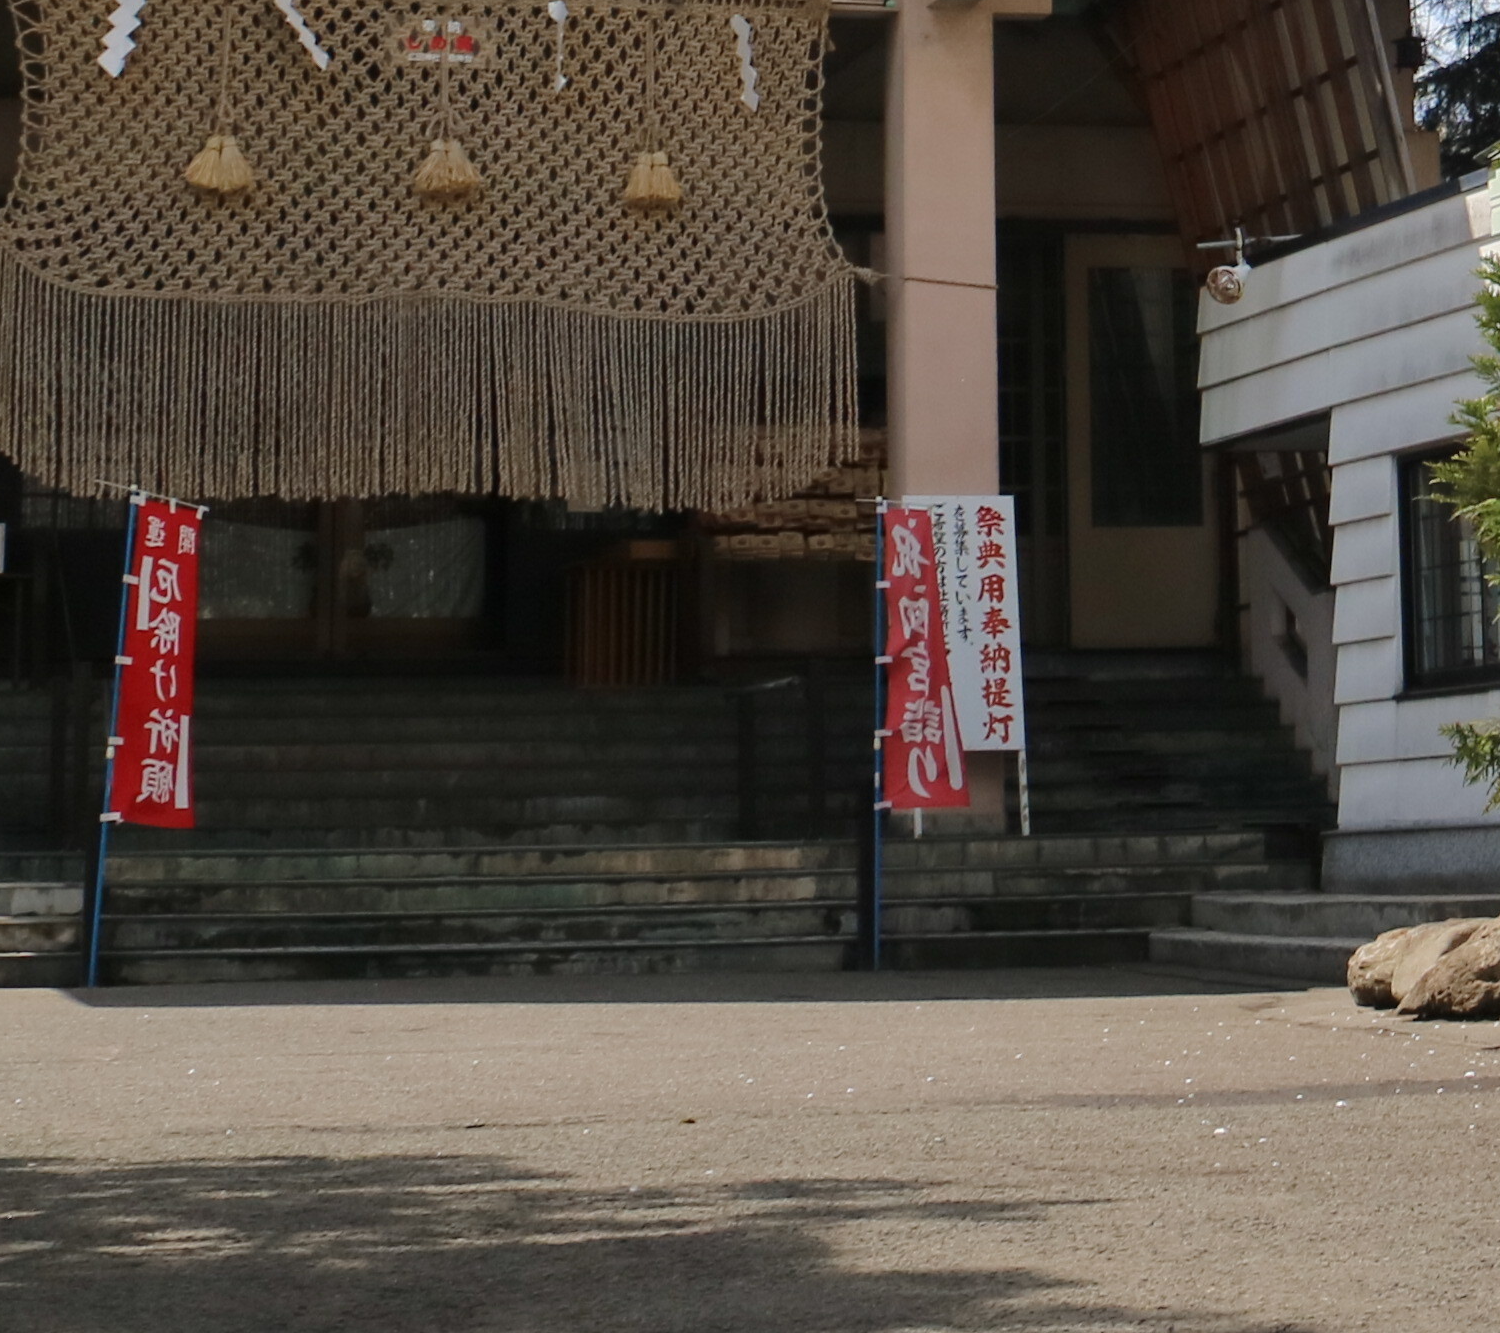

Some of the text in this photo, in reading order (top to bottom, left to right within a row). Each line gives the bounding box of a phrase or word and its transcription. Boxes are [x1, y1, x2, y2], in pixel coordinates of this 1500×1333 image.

[975, 504, 1015, 745] 祭典用奉納提灯
